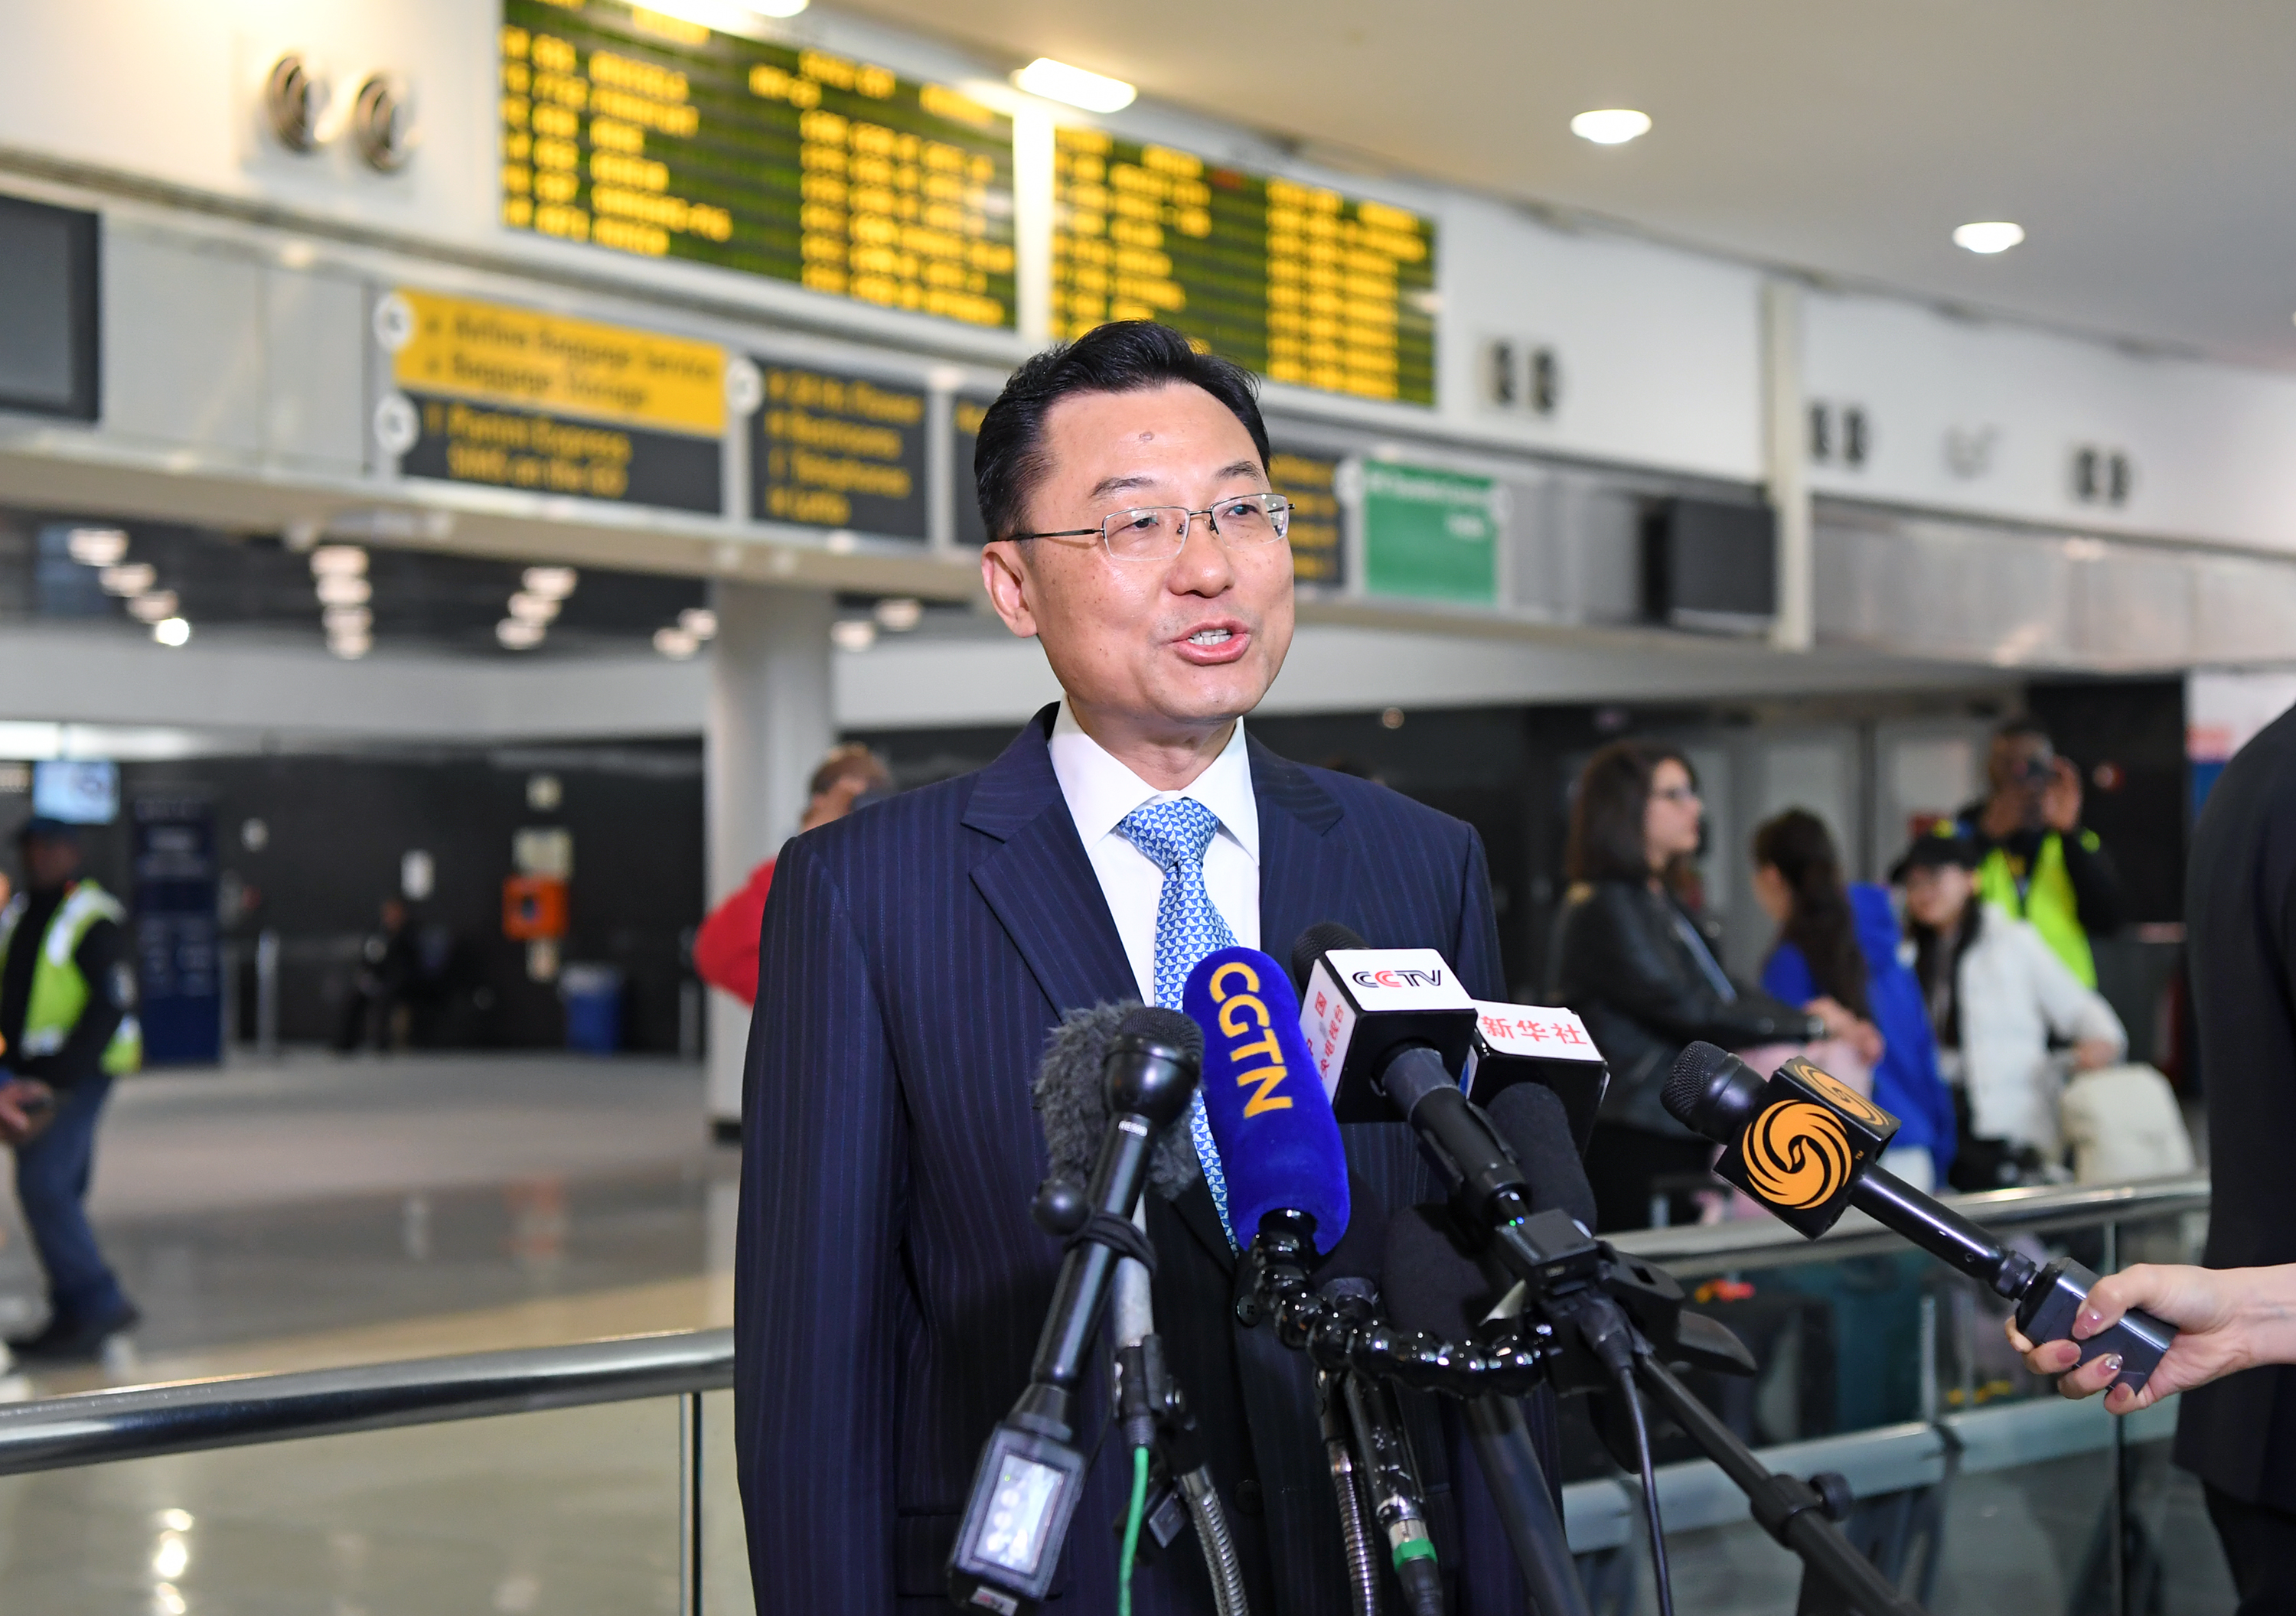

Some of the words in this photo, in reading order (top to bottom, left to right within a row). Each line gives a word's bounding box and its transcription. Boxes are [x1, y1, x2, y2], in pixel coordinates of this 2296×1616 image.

[1352, 969, 1441, 988] CCTV
[1209, 961, 1293, 1119] CGTN
[1319, 1004, 1344, 1080] 央电视台
[1480, 1015, 1588, 1044] 新华社
